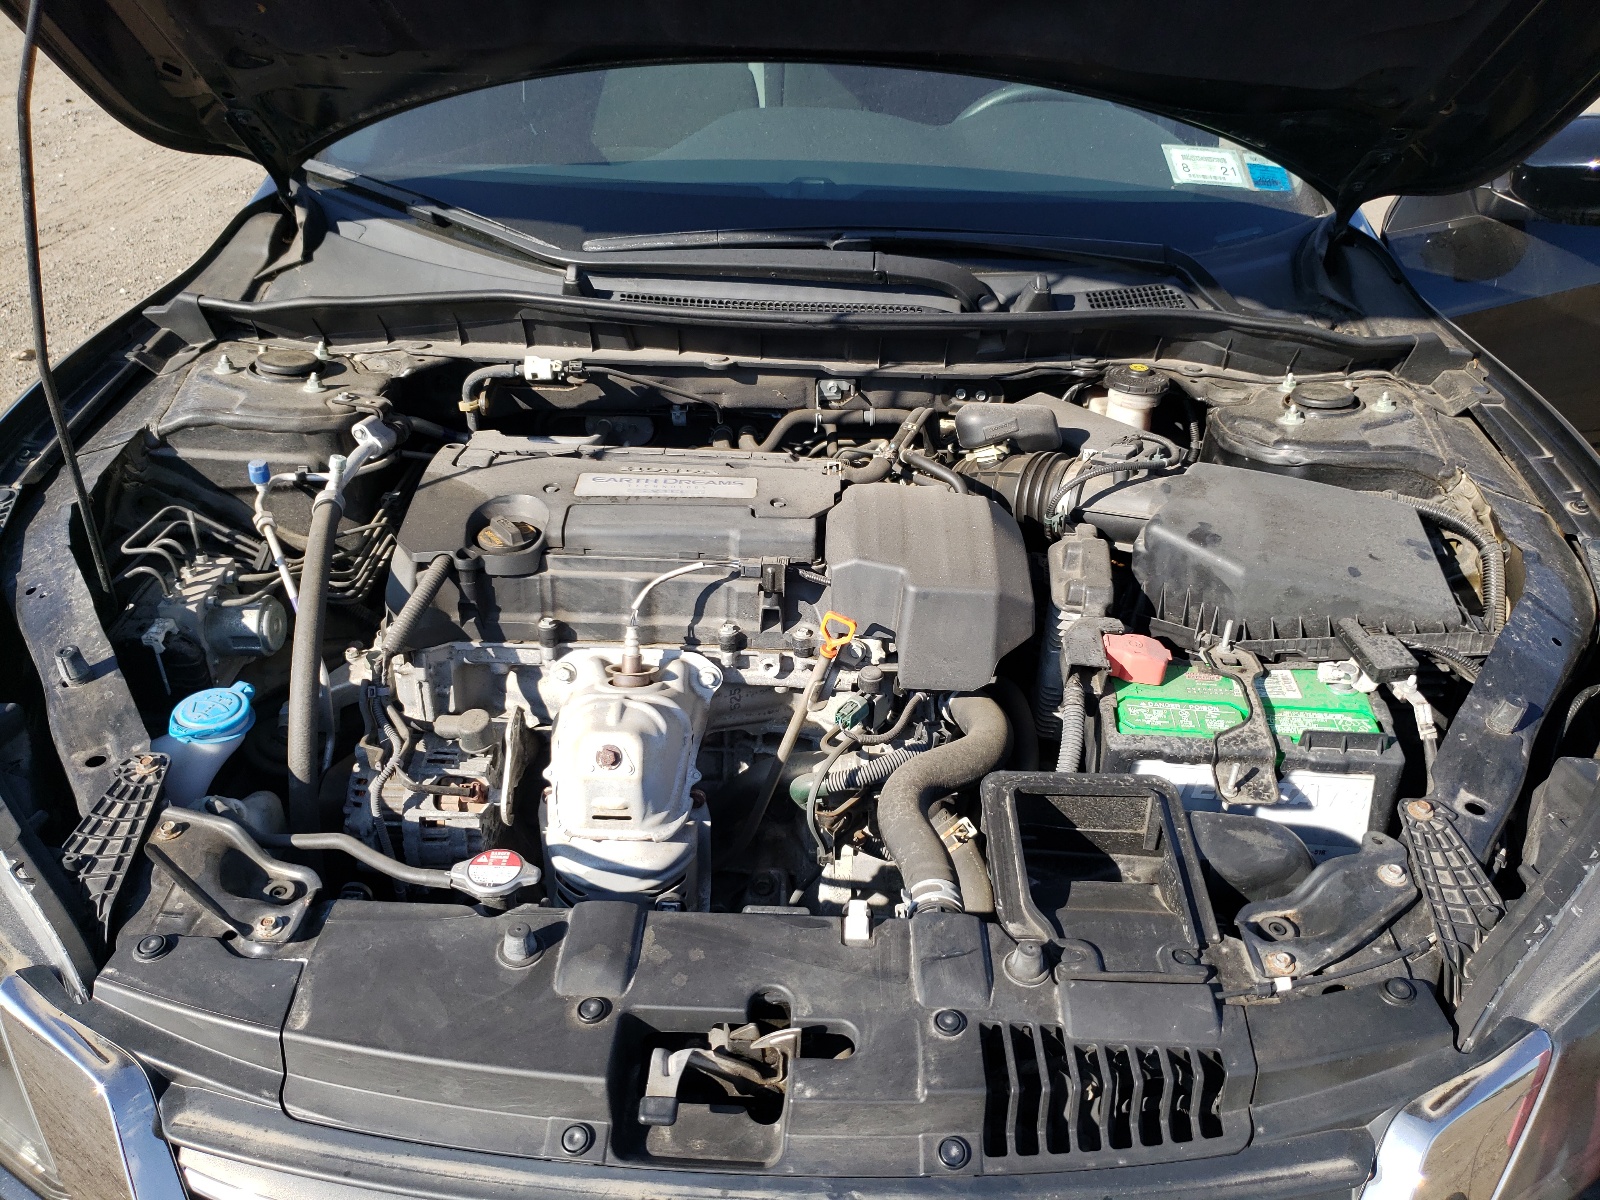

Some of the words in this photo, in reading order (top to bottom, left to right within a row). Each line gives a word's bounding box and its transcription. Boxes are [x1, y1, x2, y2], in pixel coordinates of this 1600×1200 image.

[1181, 162, 1191, 173] 8
[1220, 166, 1237, 177] 21
[592, 476, 658, 484] EARTH
[663, 478, 744, 486] DREAMS
[1147, 701, 1181, 709] DANGER
[1188, 704, 1219, 712] POISON
